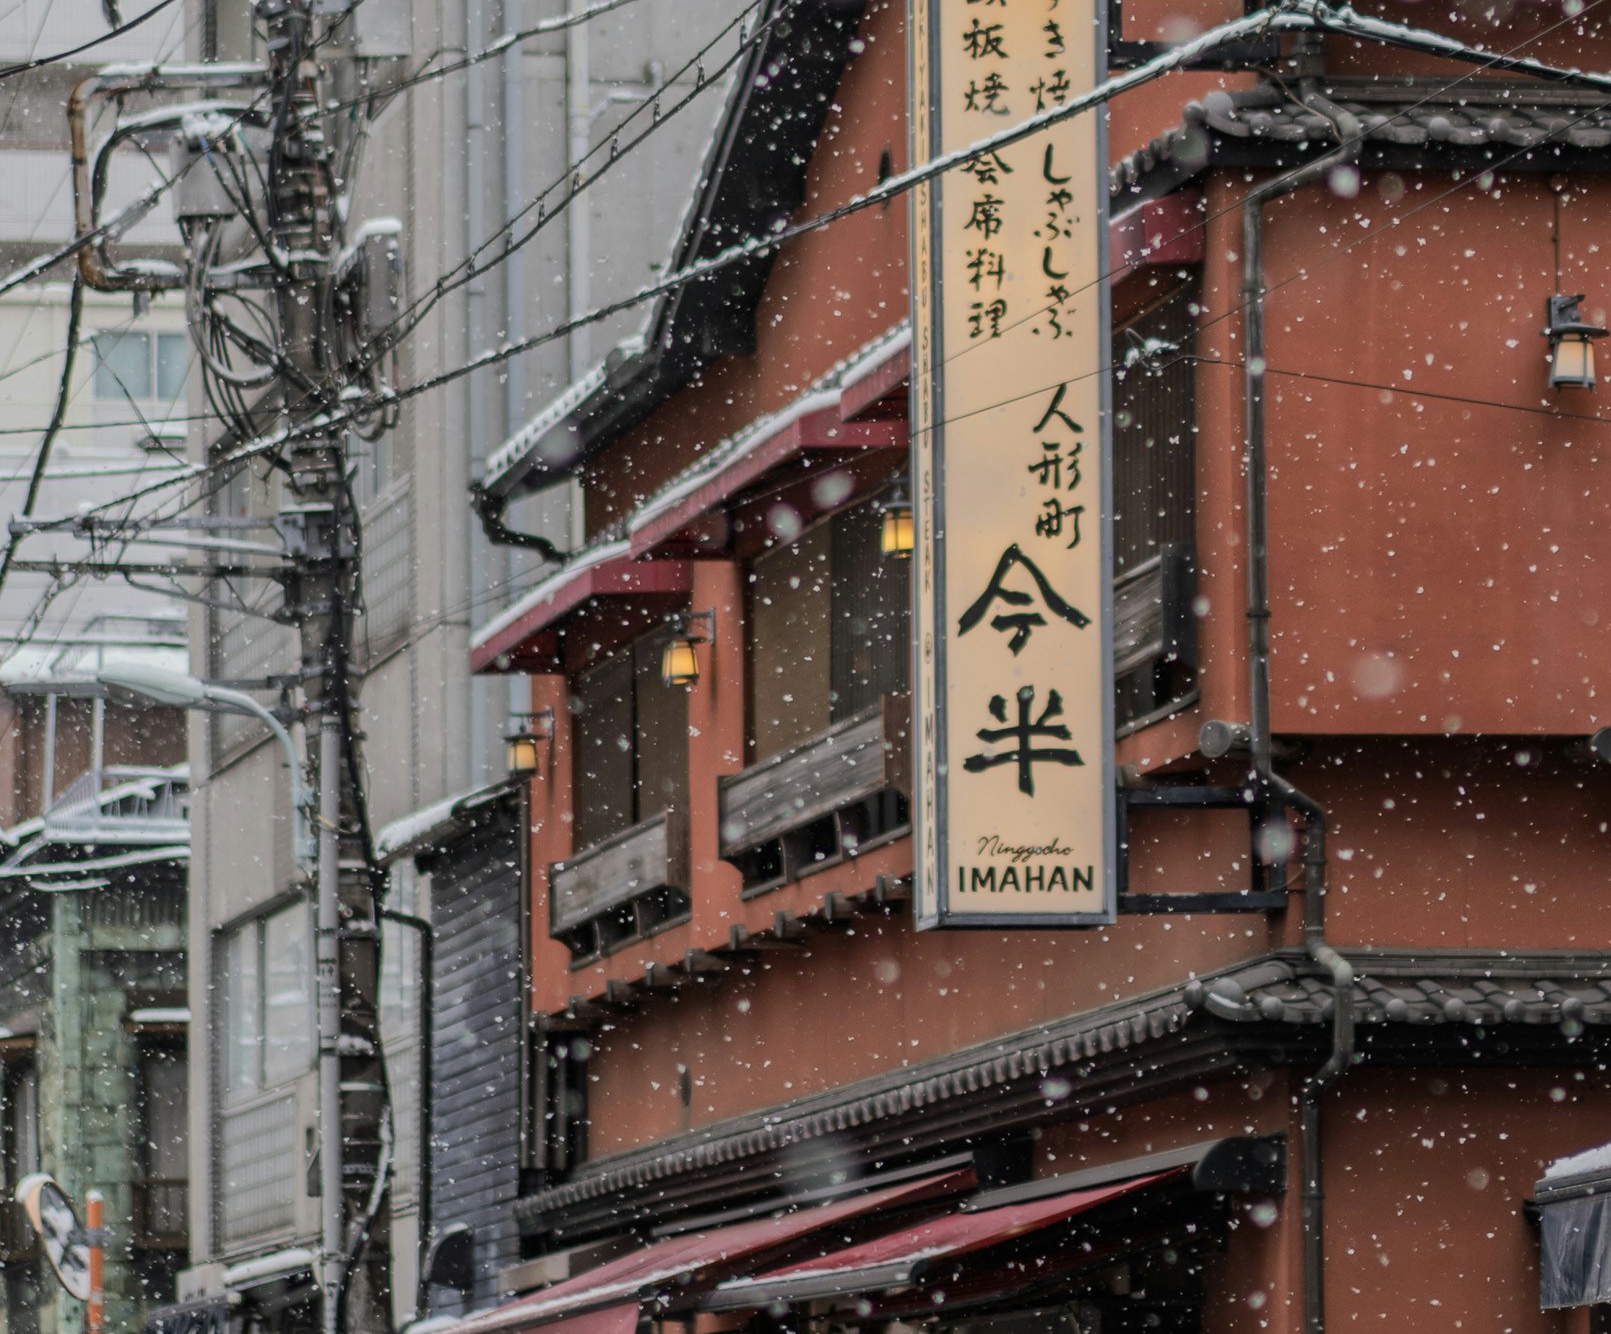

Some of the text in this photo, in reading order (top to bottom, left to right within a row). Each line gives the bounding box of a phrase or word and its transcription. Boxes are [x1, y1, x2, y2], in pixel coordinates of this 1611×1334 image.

[1028, 383, 1087, 549] 人形町
[957, 543, 1092, 797] 今半
[958, 865, 1095, 893] IMAHAN
